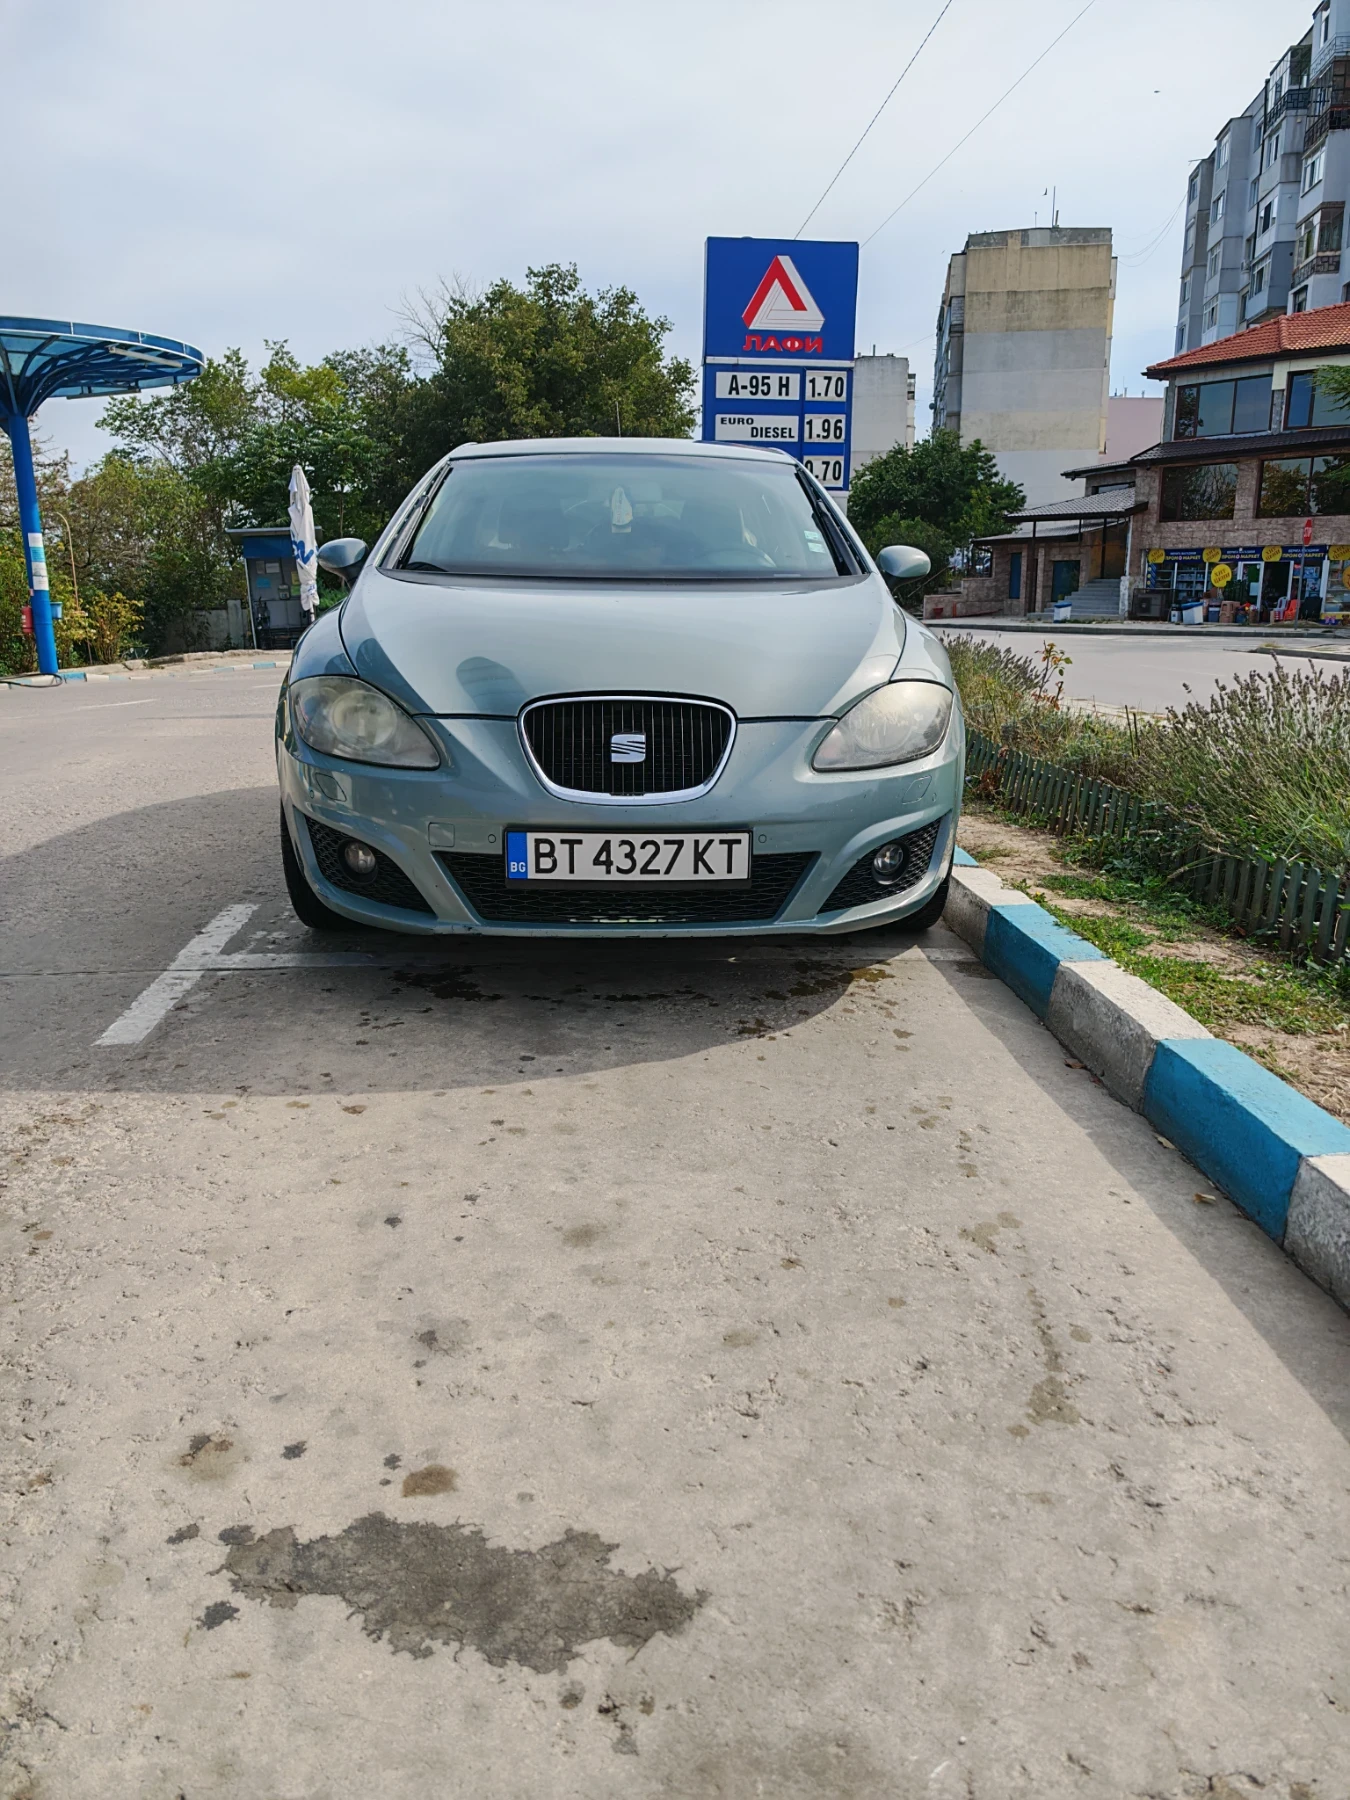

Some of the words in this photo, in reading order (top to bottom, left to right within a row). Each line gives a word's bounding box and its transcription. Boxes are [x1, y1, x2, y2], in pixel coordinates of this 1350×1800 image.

[743, 335, 823, 353] ЛАФИ
[808, 376, 844, 398] 1.70
[720, 417, 754, 426] EURO
[806, 419, 843, 440] 1.96
[750, 427, 795, 438] DIESEL
[534, 838, 583, 874] BT
[592, 839, 685, 875] 4327
[693, 838, 742, 874] KT
[510, 862, 526, 873] BG
